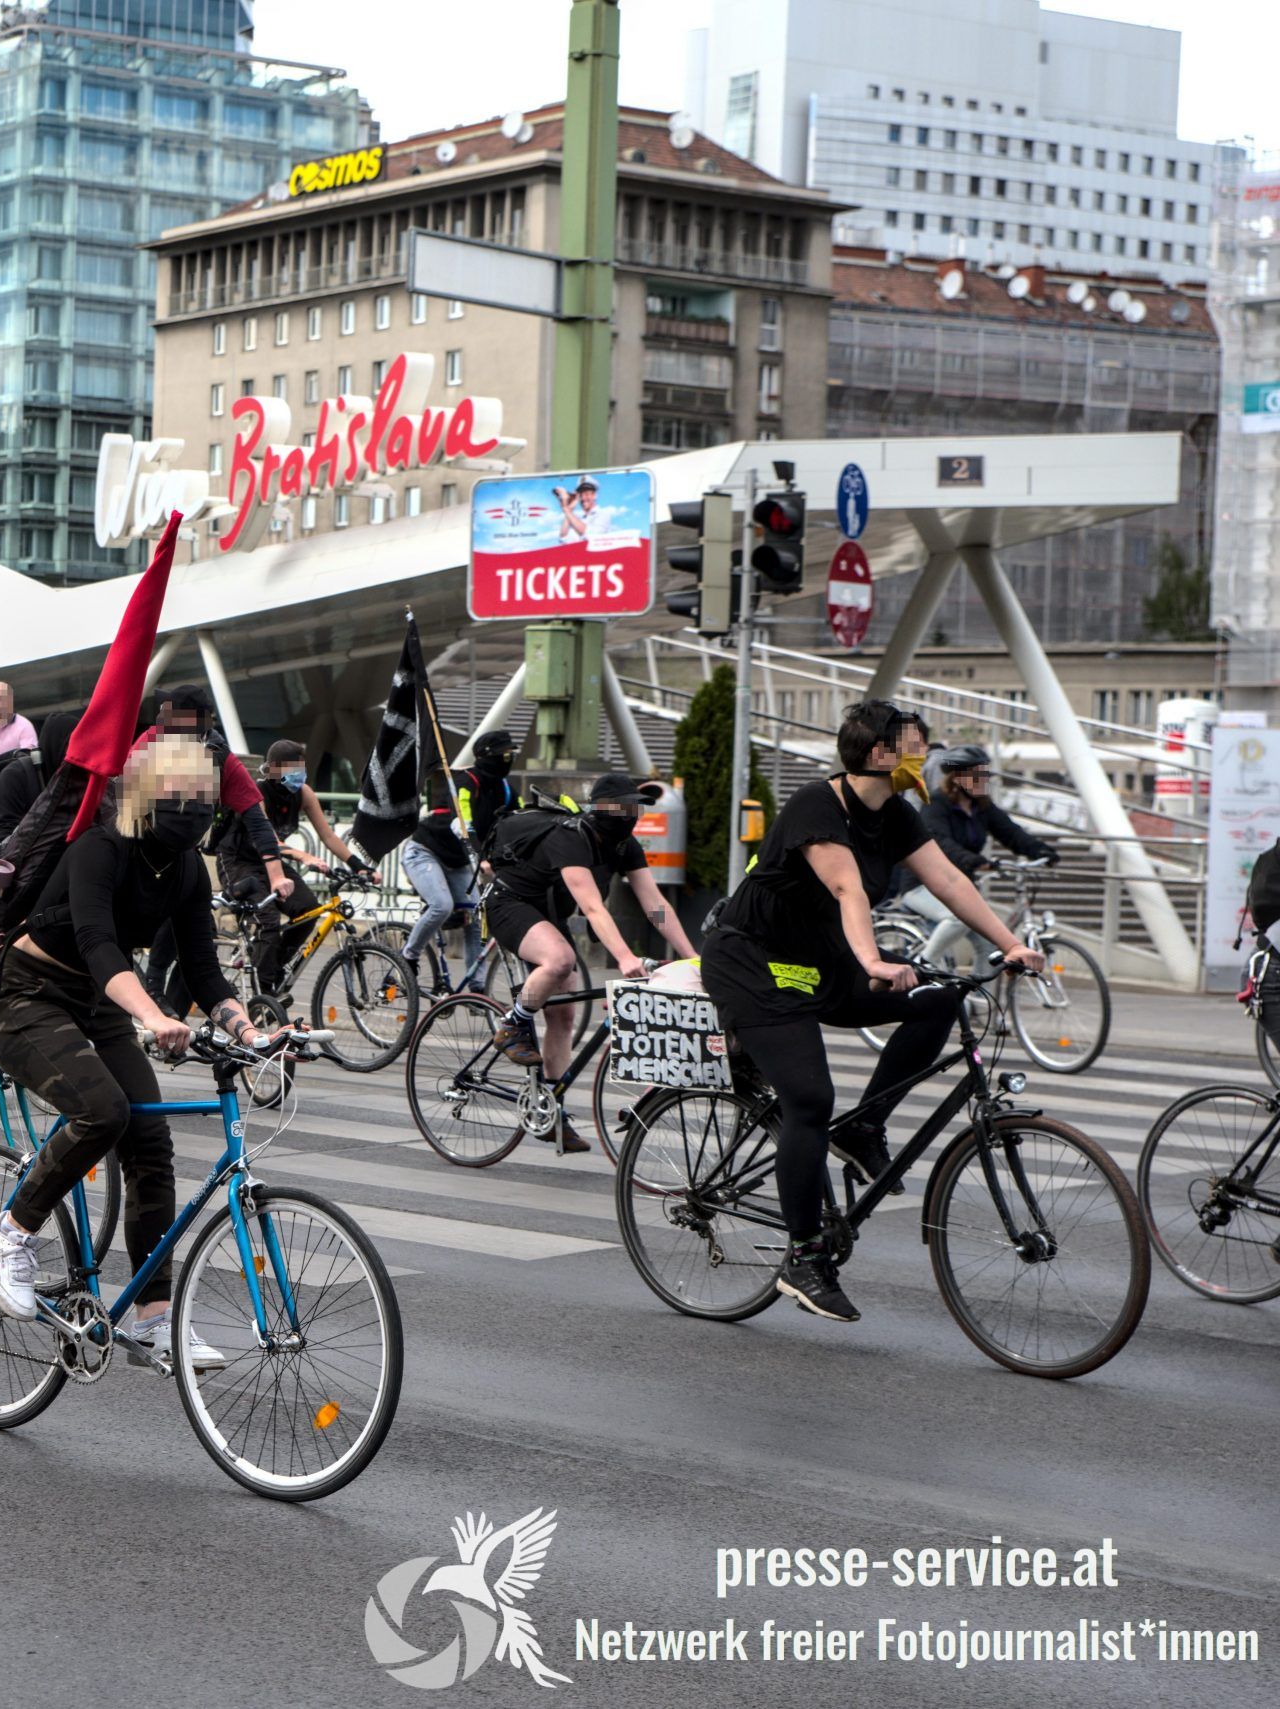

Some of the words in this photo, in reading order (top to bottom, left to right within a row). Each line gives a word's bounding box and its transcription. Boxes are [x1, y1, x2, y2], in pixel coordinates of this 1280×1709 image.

[219, 351, 505, 552] Bratislava
[952, 458, 970, 479] 2
[496, 563, 625, 601] TICKETS
[617, 991, 720, 1033] GRENZEN
[617, 1023, 702, 1061] TÖTEN
[618, 1055, 733, 1087] MENSCHEN
